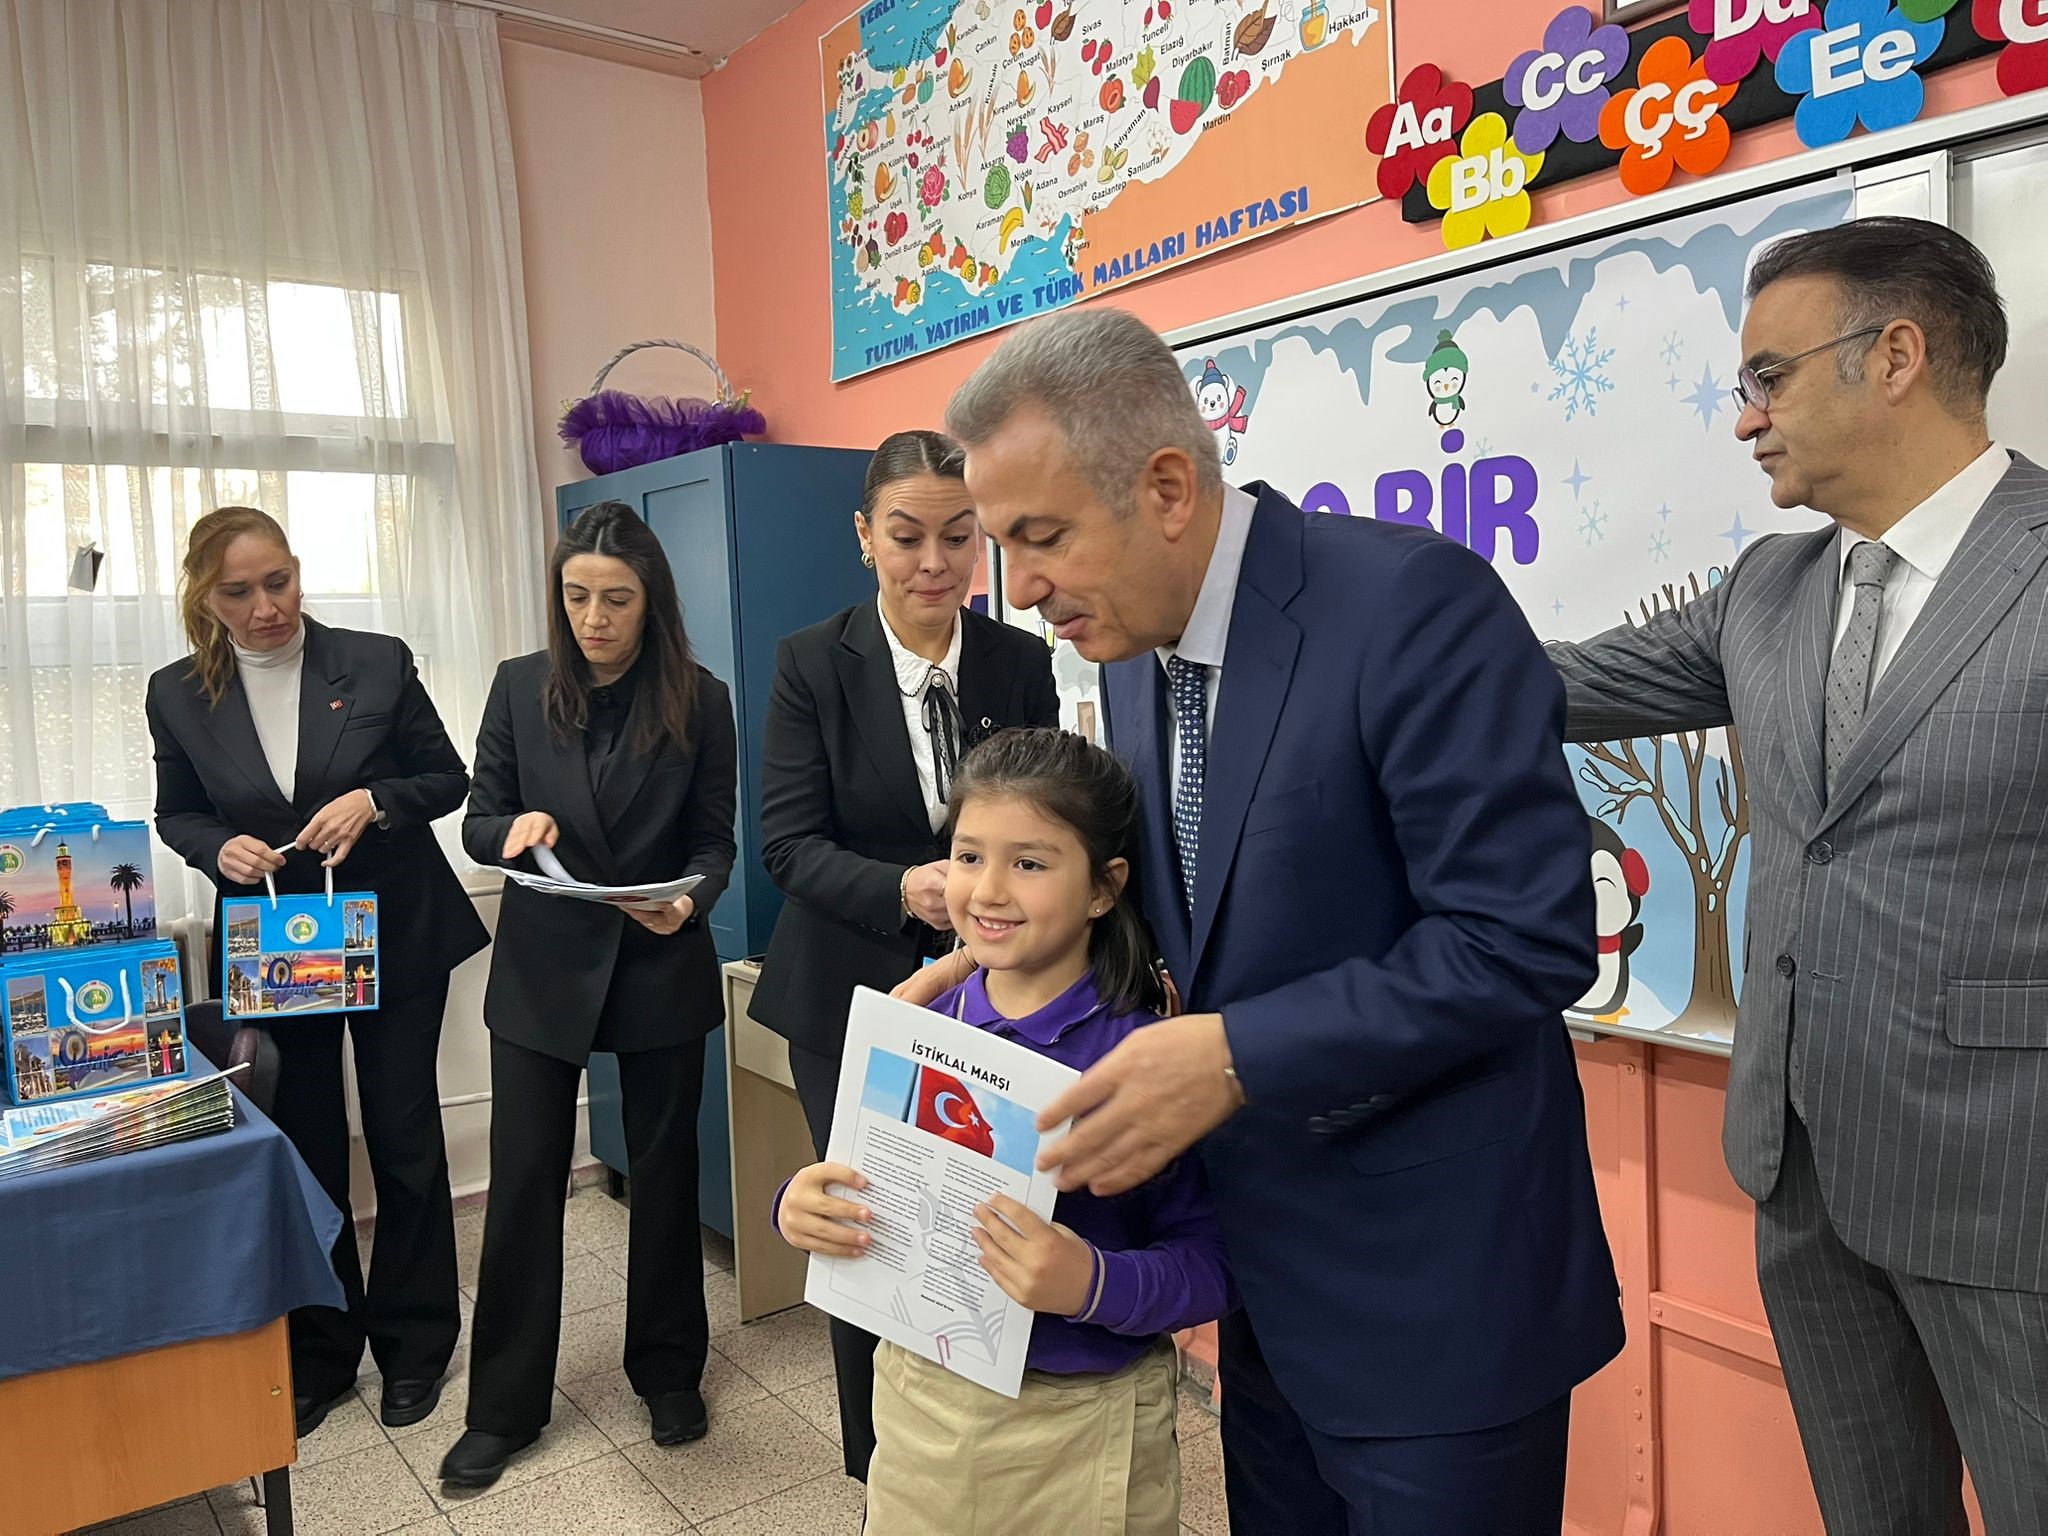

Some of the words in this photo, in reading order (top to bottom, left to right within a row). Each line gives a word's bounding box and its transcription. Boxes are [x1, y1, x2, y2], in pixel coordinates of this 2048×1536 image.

[1081, 19, 1102, 35] Sivas
[1329, 7, 1369, 34] Hakkari
[1141, 22, 1169, 44] Tunceli
[1222, 22, 1232, 65] Batman
[1160, 35, 1184, 55] Elazığ
[1171, 40, 1214, 68] Diyarbakır
[1002, 52, 1024, 69] Çorum
[1019, 52, 1041, 69] Yozgat
[1105, 52, 1134, 73] Malatya
[1261, 49, 1291, 71] Şırnak
[1810, 22, 1916, 99] Ee
[1522, 49, 1606, 111] Cc
[948, 97, 972, 113] Ankara
[1046, 95, 1073, 115] Kayseri
[1006, 107, 1037, 128] Nevşehir
[1083, 114, 1105, 127] Maraş
[1202, 113, 1231, 132] Mardin
[1624, 79, 1719, 160] Çç
[1113, 109, 1146, 151] Adıyaman
[1384, 101, 1453, 159] Aa
[980, 155, 1005, 171] Aksaray
[1127, 156, 1160, 178] Şanlıurfa
[1014, 168, 1033, 182] Niğde
[1036, 177, 1058, 191] Adana
[1451, 147, 1526, 213] Bb
[957, 189, 977, 202] Konya
[1057, 181, 1088, 199] Osmaniye
[1091, 180, 1127, 201] Gaziantep
[976, 214, 1004, 231] Karaman
[1010, 234, 1034, 248] Mersin
[864, 333, 918, 365] TUTUM,
[925, 304, 990, 345] YATIRIM
[997, 294, 1023, 319] VE
[1032, 273, 1085, 309] TÜRK
[1093, 231, 1186, 288] MALLARI
[1196, 186, 1308, 249] HAFTASI
[911, 1039, 967, 1073] İSTİKLAL
[970, 1065, 1010, 1091] MARŞI
